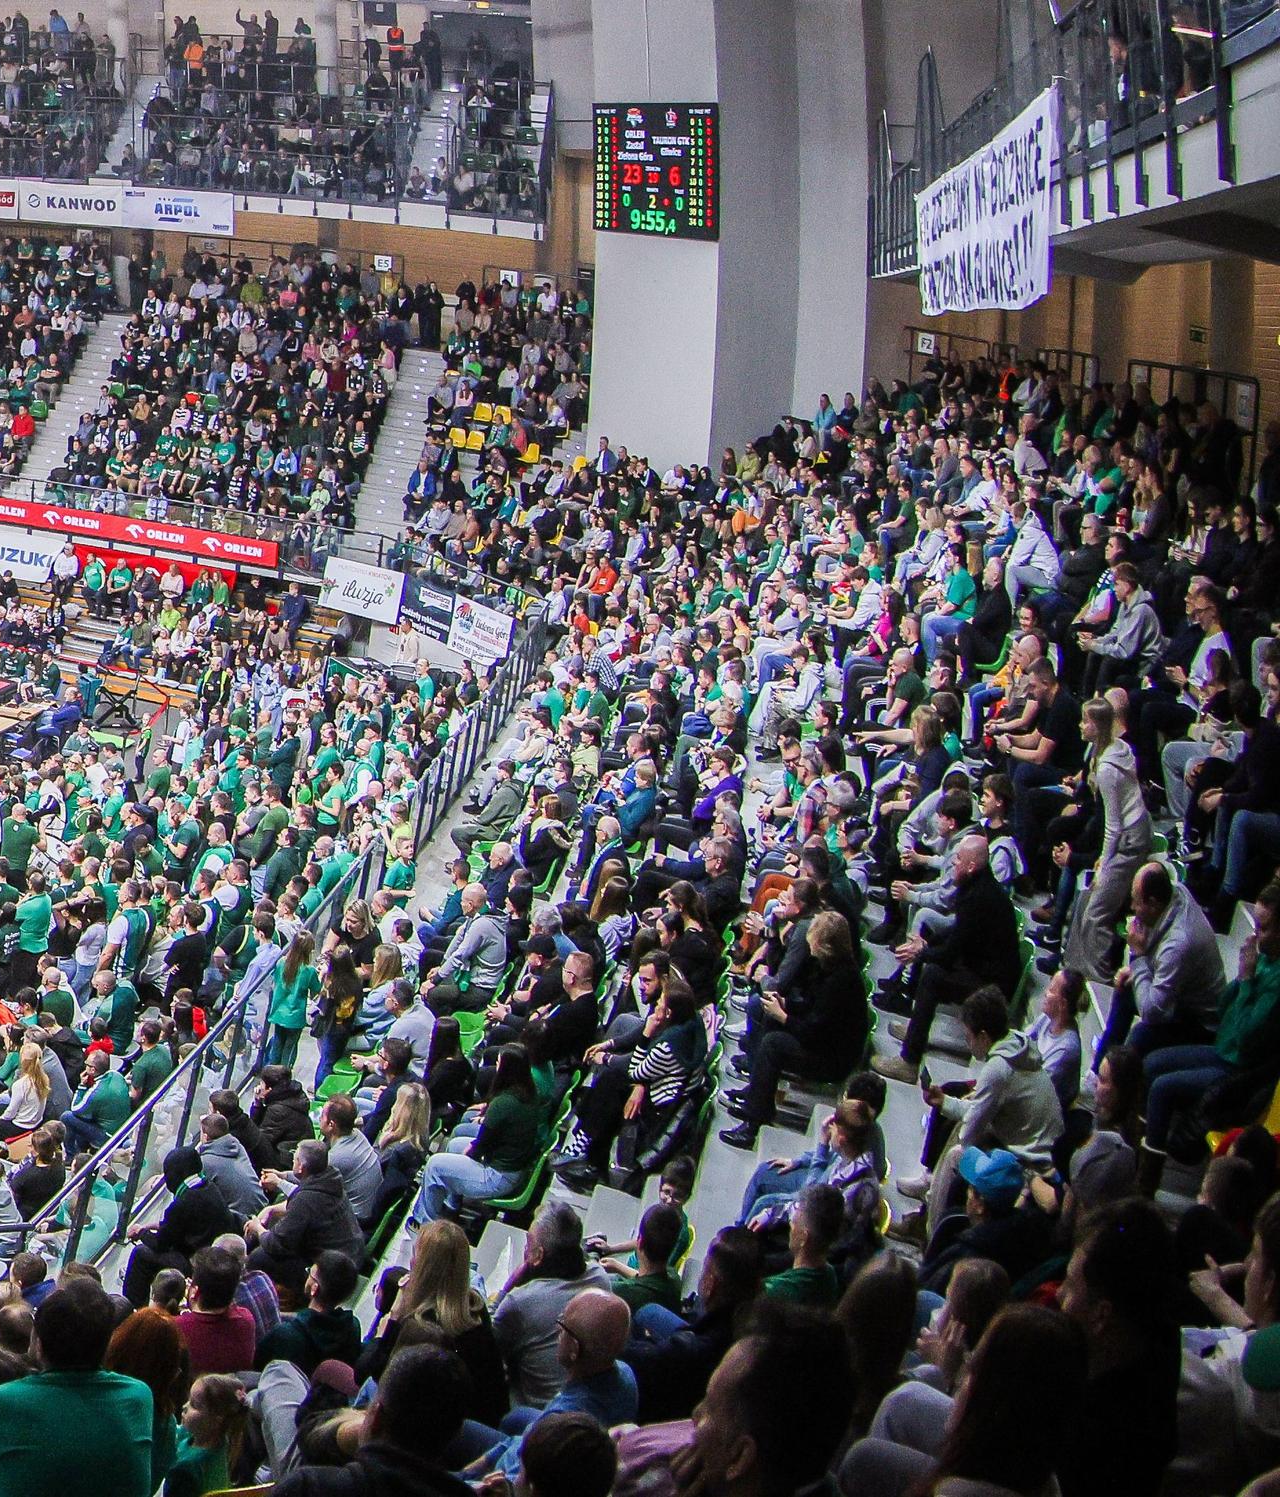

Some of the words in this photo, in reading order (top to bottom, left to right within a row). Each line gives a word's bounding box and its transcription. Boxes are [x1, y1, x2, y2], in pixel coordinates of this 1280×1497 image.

[623, 164, 643, 184] 23
[669, 166, 681, 186] 6
[46, 196, 117, 212] KANWOD
[623, 193, 631, 206] 0
[649, 194, 656, 209] 2
[675, 197, 684, 211] 0
[154, 203, 200, 217] ARPOL
[62, 515, 100, 530] ORLEN
[146, 529, 184, 544] ORLEN
[224, 542, 262, 557] ORLEN
[342, 580, 384, 609] iluzja
